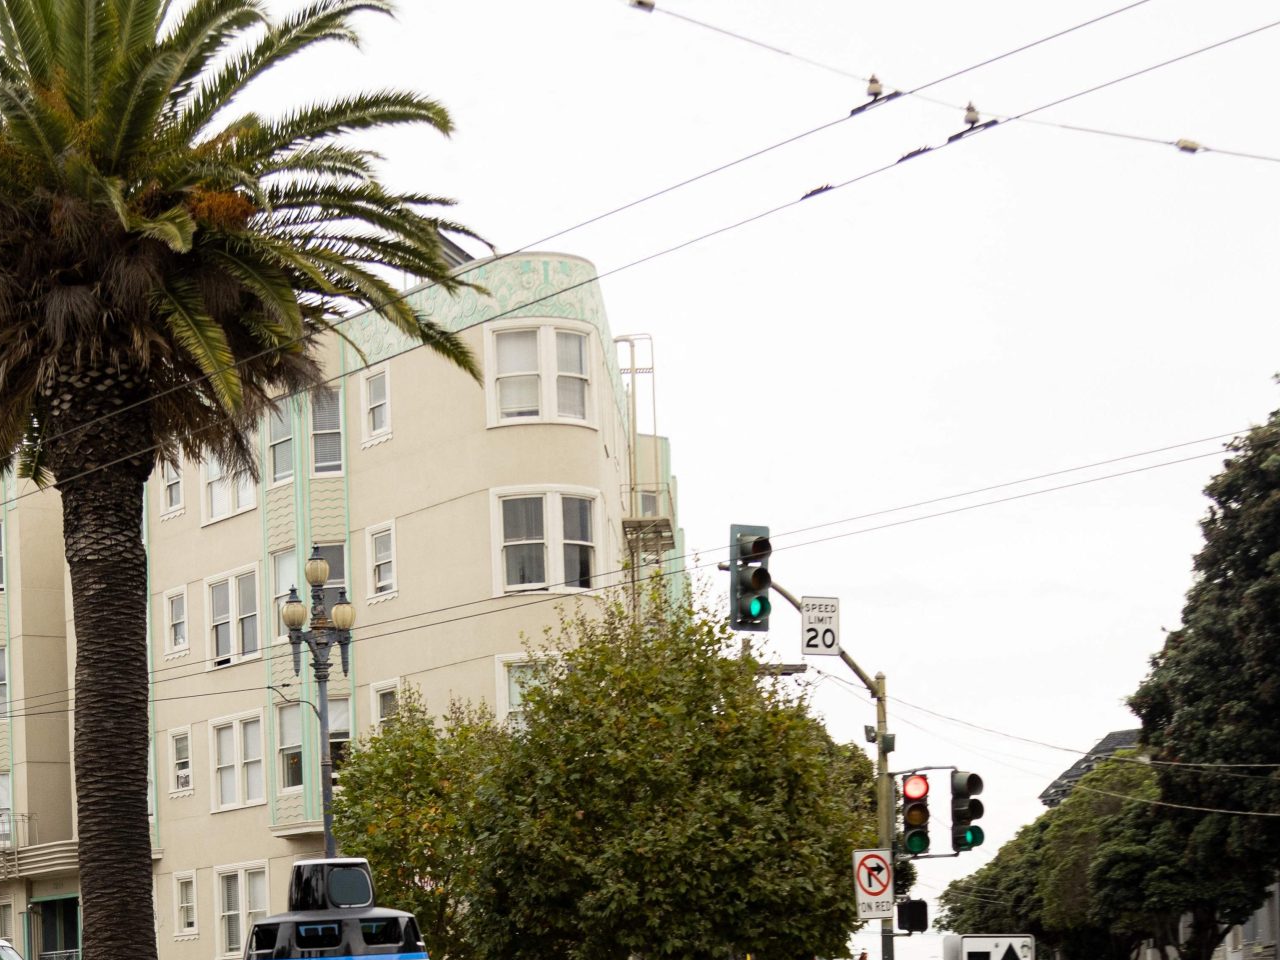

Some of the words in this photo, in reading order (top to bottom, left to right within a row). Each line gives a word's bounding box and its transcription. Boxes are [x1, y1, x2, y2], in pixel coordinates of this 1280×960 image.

[805, 603, 836, 613] SPEED
[808, 616, 833, 625] LIMIT
[806, 628, 835, 649] 20
[861, 902, 873, 913] ON
[875, 901, 891, 912] RED
